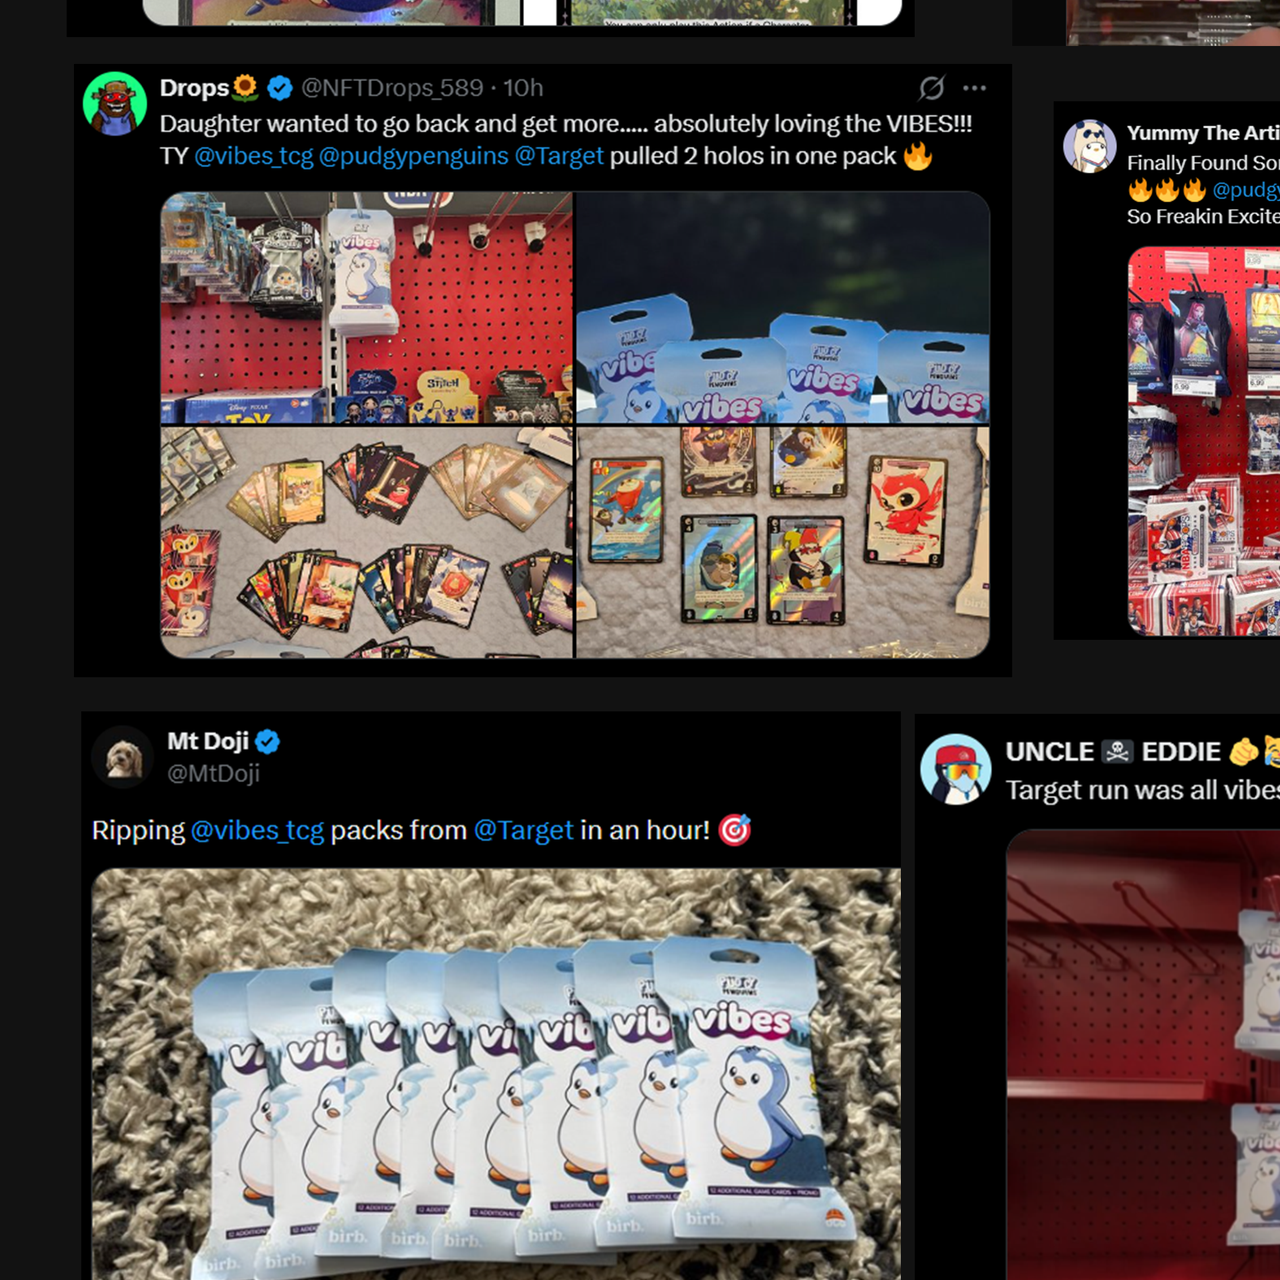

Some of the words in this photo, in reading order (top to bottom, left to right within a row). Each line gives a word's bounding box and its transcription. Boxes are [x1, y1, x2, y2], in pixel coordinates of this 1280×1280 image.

[789, 362, 859, 398] vibes
[167, 731, 200, 751] Mt
[204, 730, 249, 754] Doji
[168, 762, 260, 787] @MtDoji
[1005, 779, 1083, 806] Target
[1089, 784, 1129, 801] run
[1134, 784, 1185, 801] was
[1190, 778, 1218, 801] all
[693, 1000, 791, 1040] vibes
